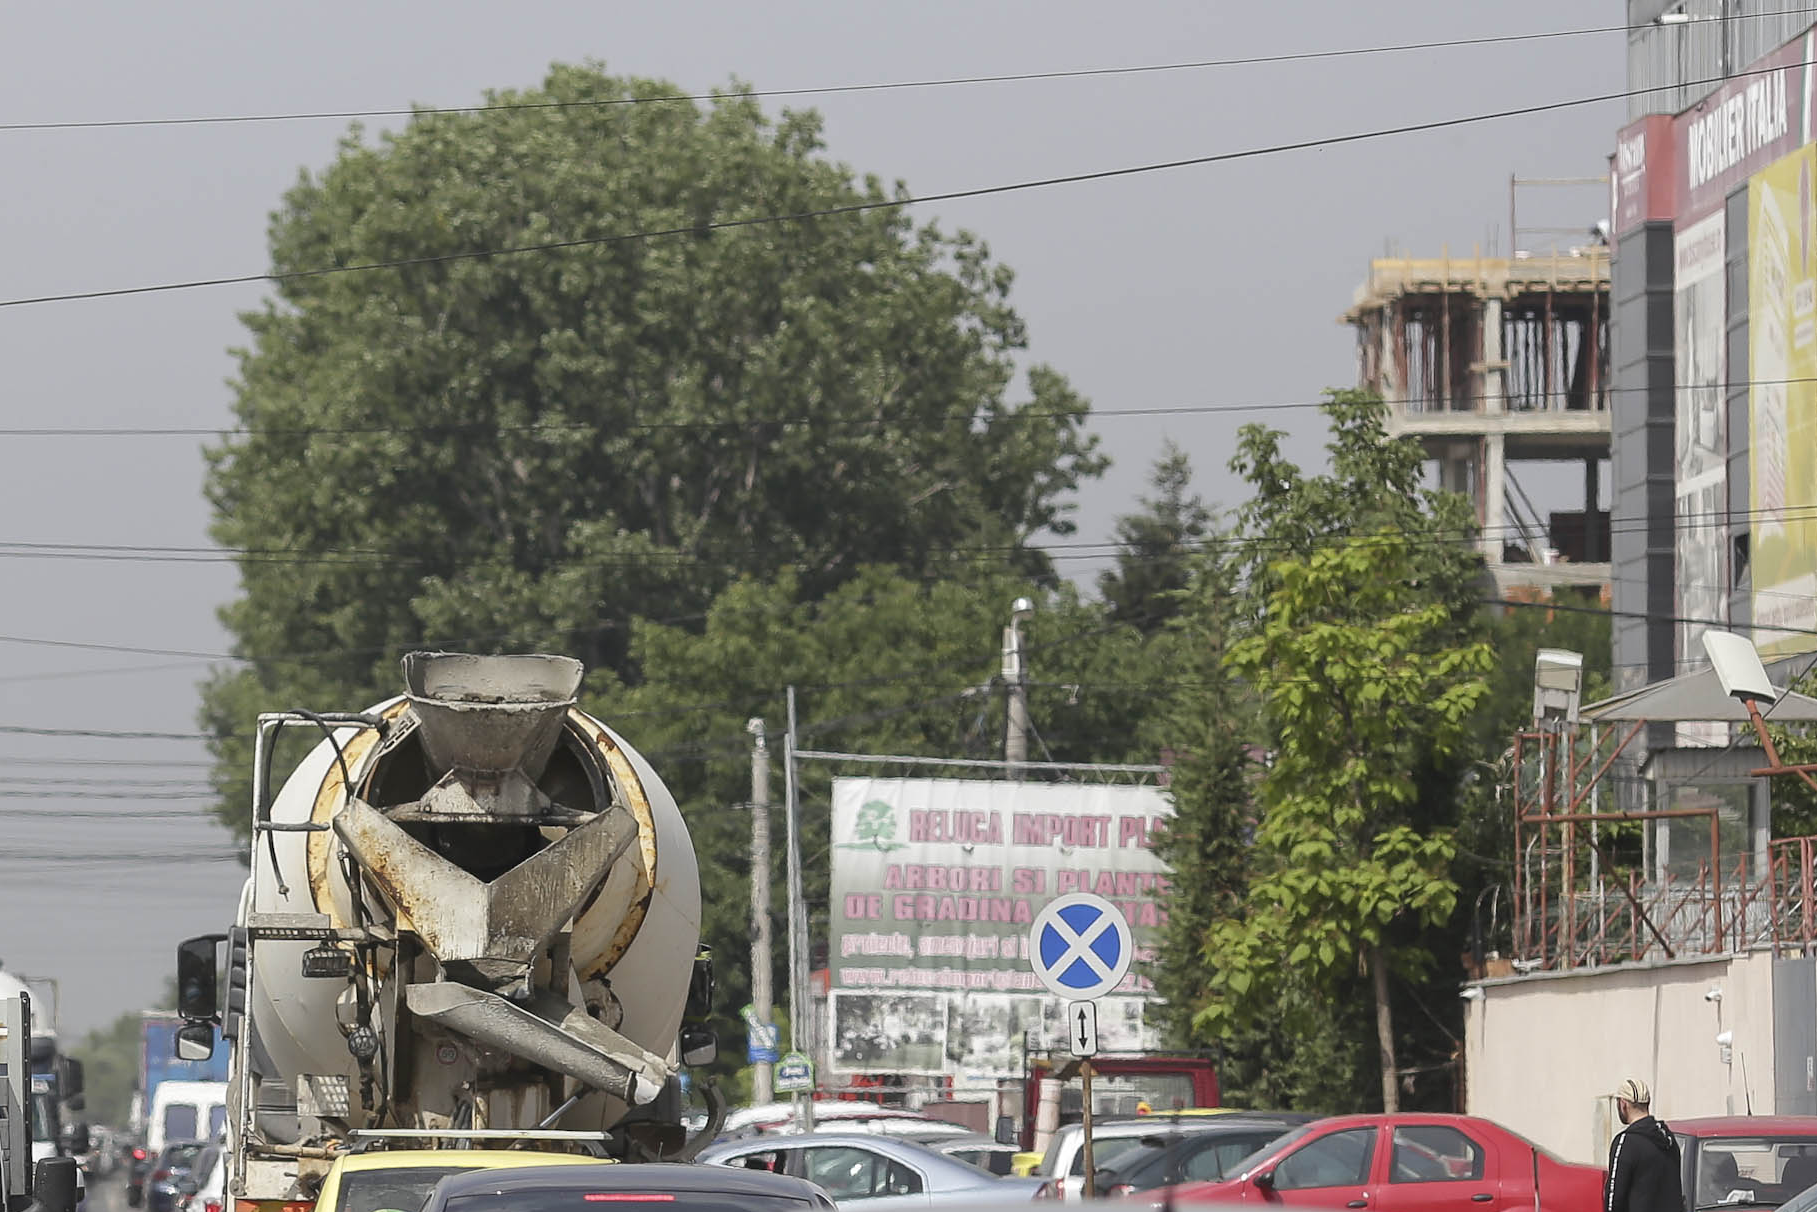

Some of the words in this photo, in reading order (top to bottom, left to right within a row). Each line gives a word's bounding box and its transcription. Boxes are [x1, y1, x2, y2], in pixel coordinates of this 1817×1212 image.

[1746, 68, 1788, 155] ITALIA
[1013, 813, 1112, 848] IMPORT
[884, 864, 1003, 891] ARBORI
[1013, 868, 1046, 894] SI
[844, 893, 883, 920] DE
[893, 894, 1032, 923] GRADINA
